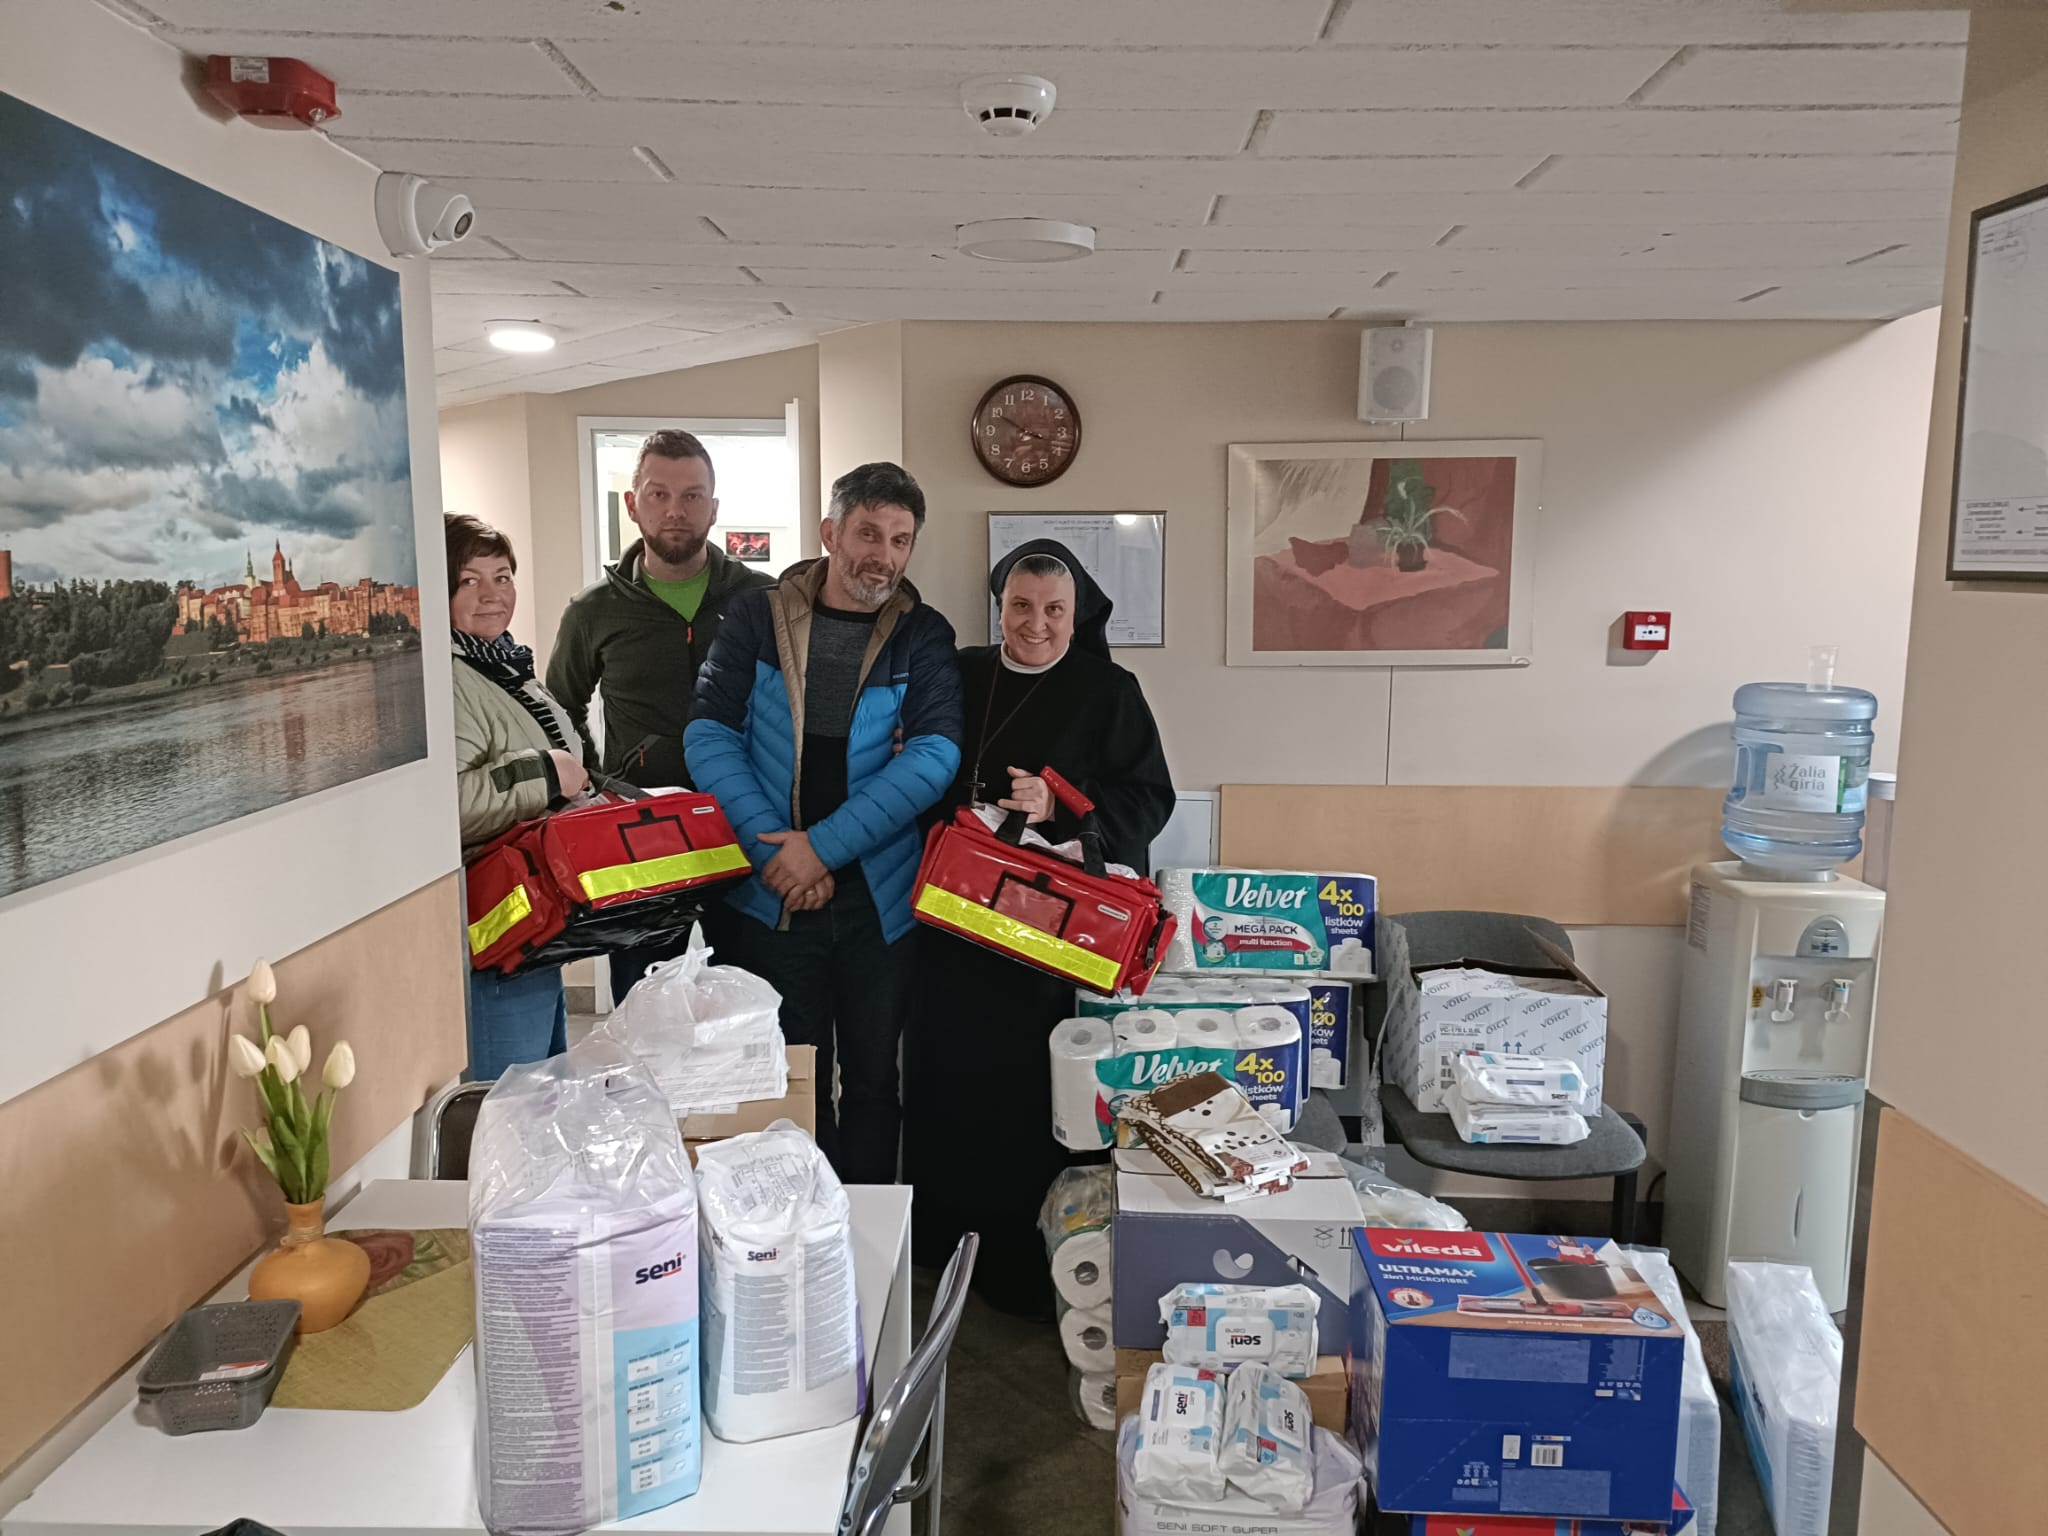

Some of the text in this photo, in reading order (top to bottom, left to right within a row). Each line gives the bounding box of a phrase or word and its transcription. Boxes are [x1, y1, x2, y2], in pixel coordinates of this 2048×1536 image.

[1004, 394, 1015, 406] 11
[1020, 390, 1034, 401] 12
[1043, 394, 1049, 406] 1
[991, 408, 1003, 418] 10
[1054, 409, 1064, 419] 2
[986, 425, 996, 436] 9
[1057, 426, 1067, 438] 3
[991, 444, 1000, 455] 8
[1052, 446, 1062, 456] 4
[1004, 458, 1014, 468] 7
[1021, 462, 1031, 473] 6
[1039, 458, 1049, 469] 5
[1788, 763, 1826, 779] Žalia
[1790, 778, 1825, 792] giria
[1224, 876, 1309, 909] Velvet
[1318, 880, 1352, 905] 4x
[1338, 903, 1365, 916] 100
[1325, 916, 1364, 928] listków
[1234, 924, 1299, 935] MEGA PACK
[1330, 926, 1359, 936] sheets
[1239, 937, 1293, 947] multi function
[1442, 991, 1473, 1010] VOIGT
[1521, 996, 1552, 1016] VOIGT
[1461, 1003, 1492, 1023] VOIGT
[1540, 1008, 1571, 1028] VOIGT
[1559, 1021, 1589, 1042] VOIGT
[1131, 1053, 1223, 1085] Velvet
[1235, 1052, 1273, 1073] 4x
[1256, 1070, 1286, 1084] 100
[747, 1248, 778, 1262] seni
[1382, 1241, 1483, 1257] vileda
[635, 1252, 684, 1285] seni
[1378, 1263, 1477, 1278] ULTRAMAX
[1406, 1275, 1470, 1285] MICROFIBRE
[1230, 1335, 1261, 1348] seni
[1175, 1393, 1188, 1415] seni
[1156, 1521, 1278, 1535] SENI SOFT SUPER
